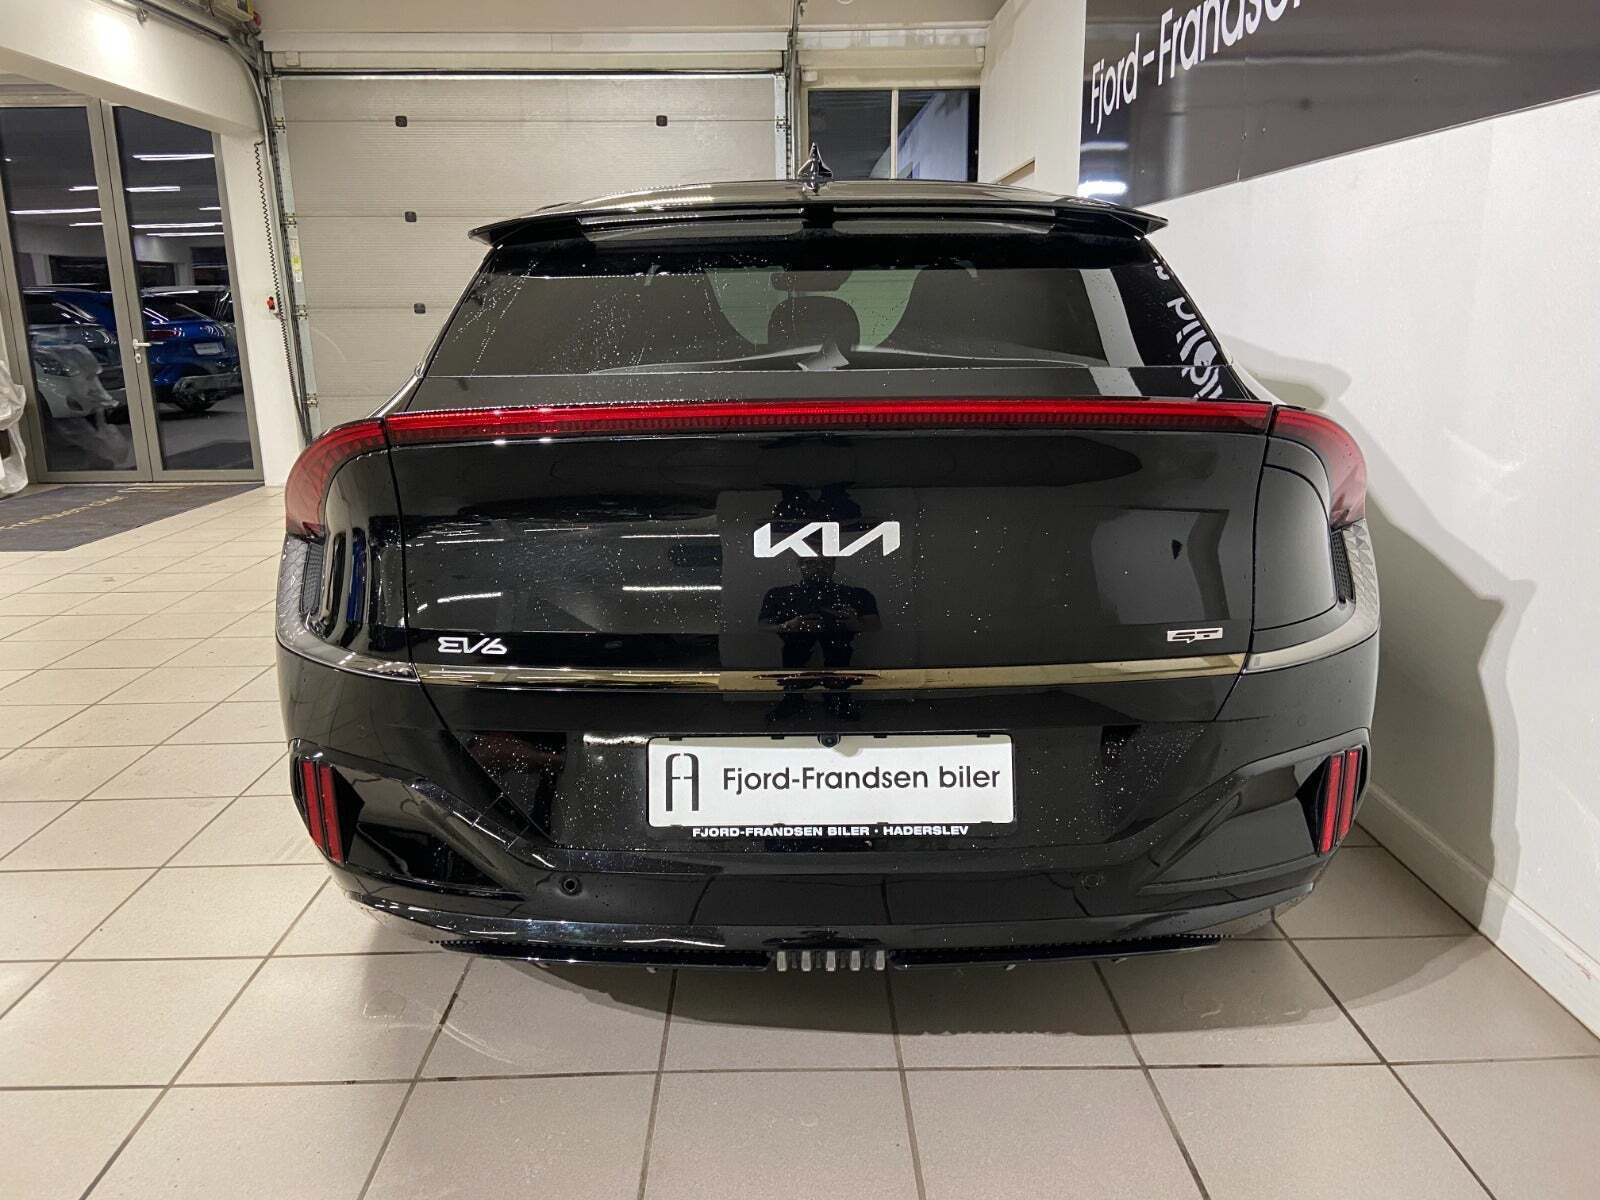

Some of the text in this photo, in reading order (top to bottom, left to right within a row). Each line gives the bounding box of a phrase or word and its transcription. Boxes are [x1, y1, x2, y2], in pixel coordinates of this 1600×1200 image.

[753, 521, 901, 558] KIA
[437, 636, 508, 655] EV6
[722, 765, 1001, 796] Fjord-Frandsen biler
[692, 825, 969, 838] FJORD-FRANDSEN BILER HADERSLEV
